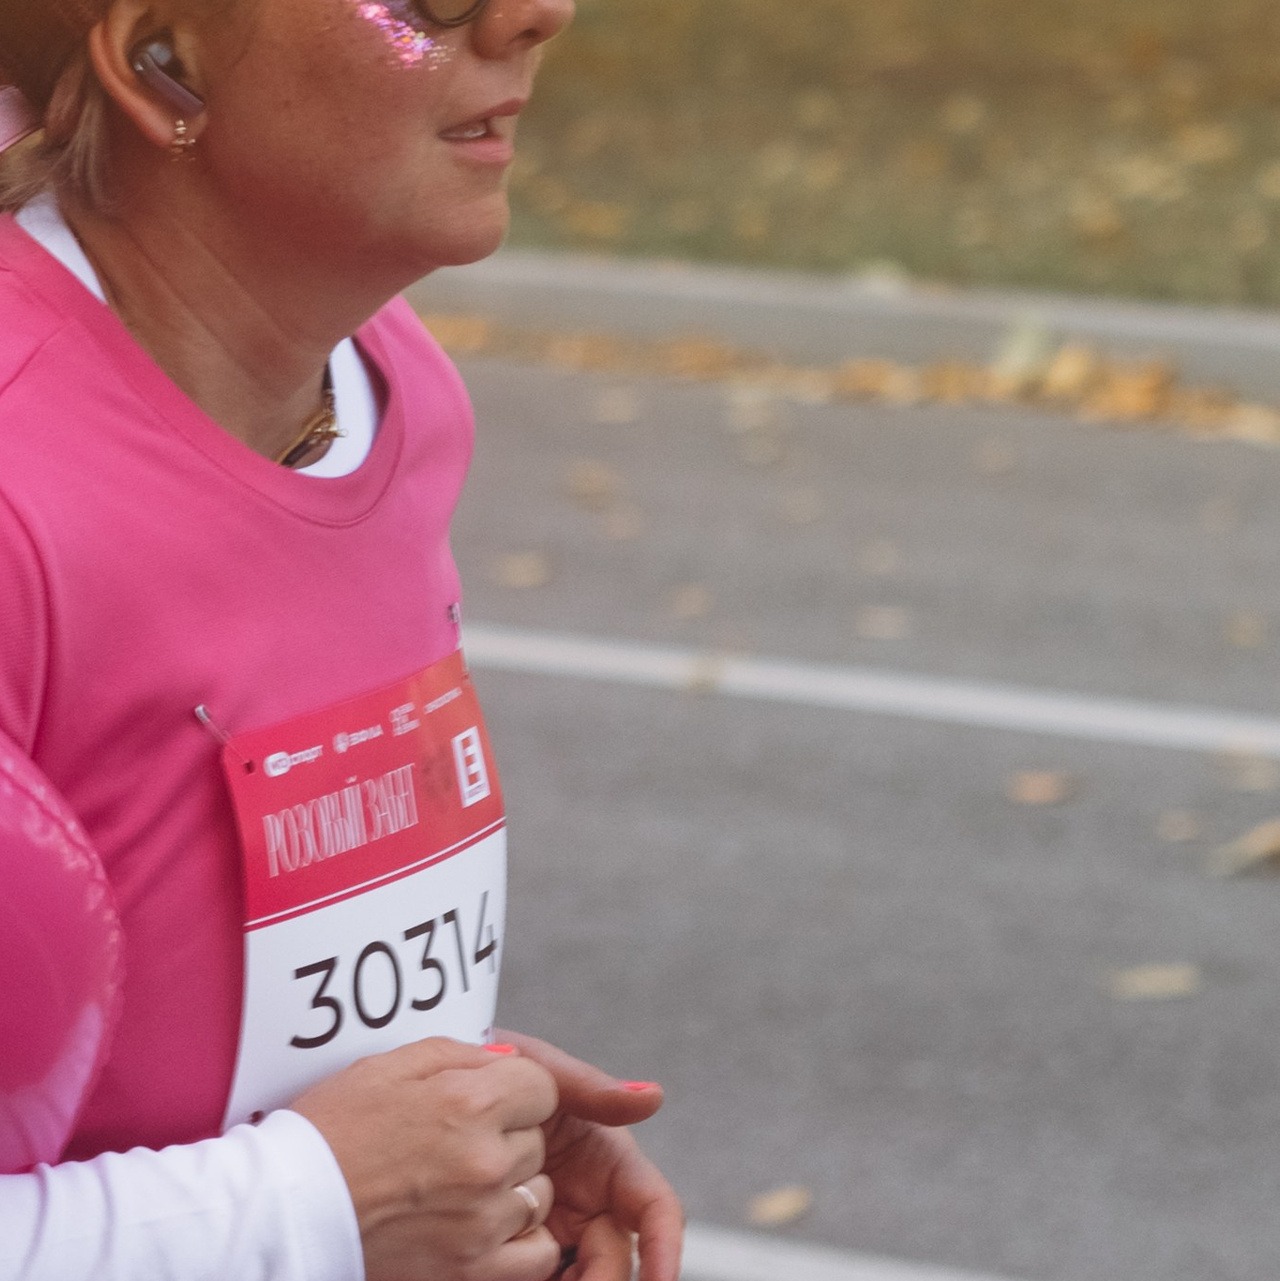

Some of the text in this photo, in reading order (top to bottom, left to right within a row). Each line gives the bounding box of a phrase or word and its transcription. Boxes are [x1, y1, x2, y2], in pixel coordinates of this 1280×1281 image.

[262, 763, 420, 879] РОЗОВЫЙ ЗАБЕГ
[289, 889, 498, 1050] 30314
